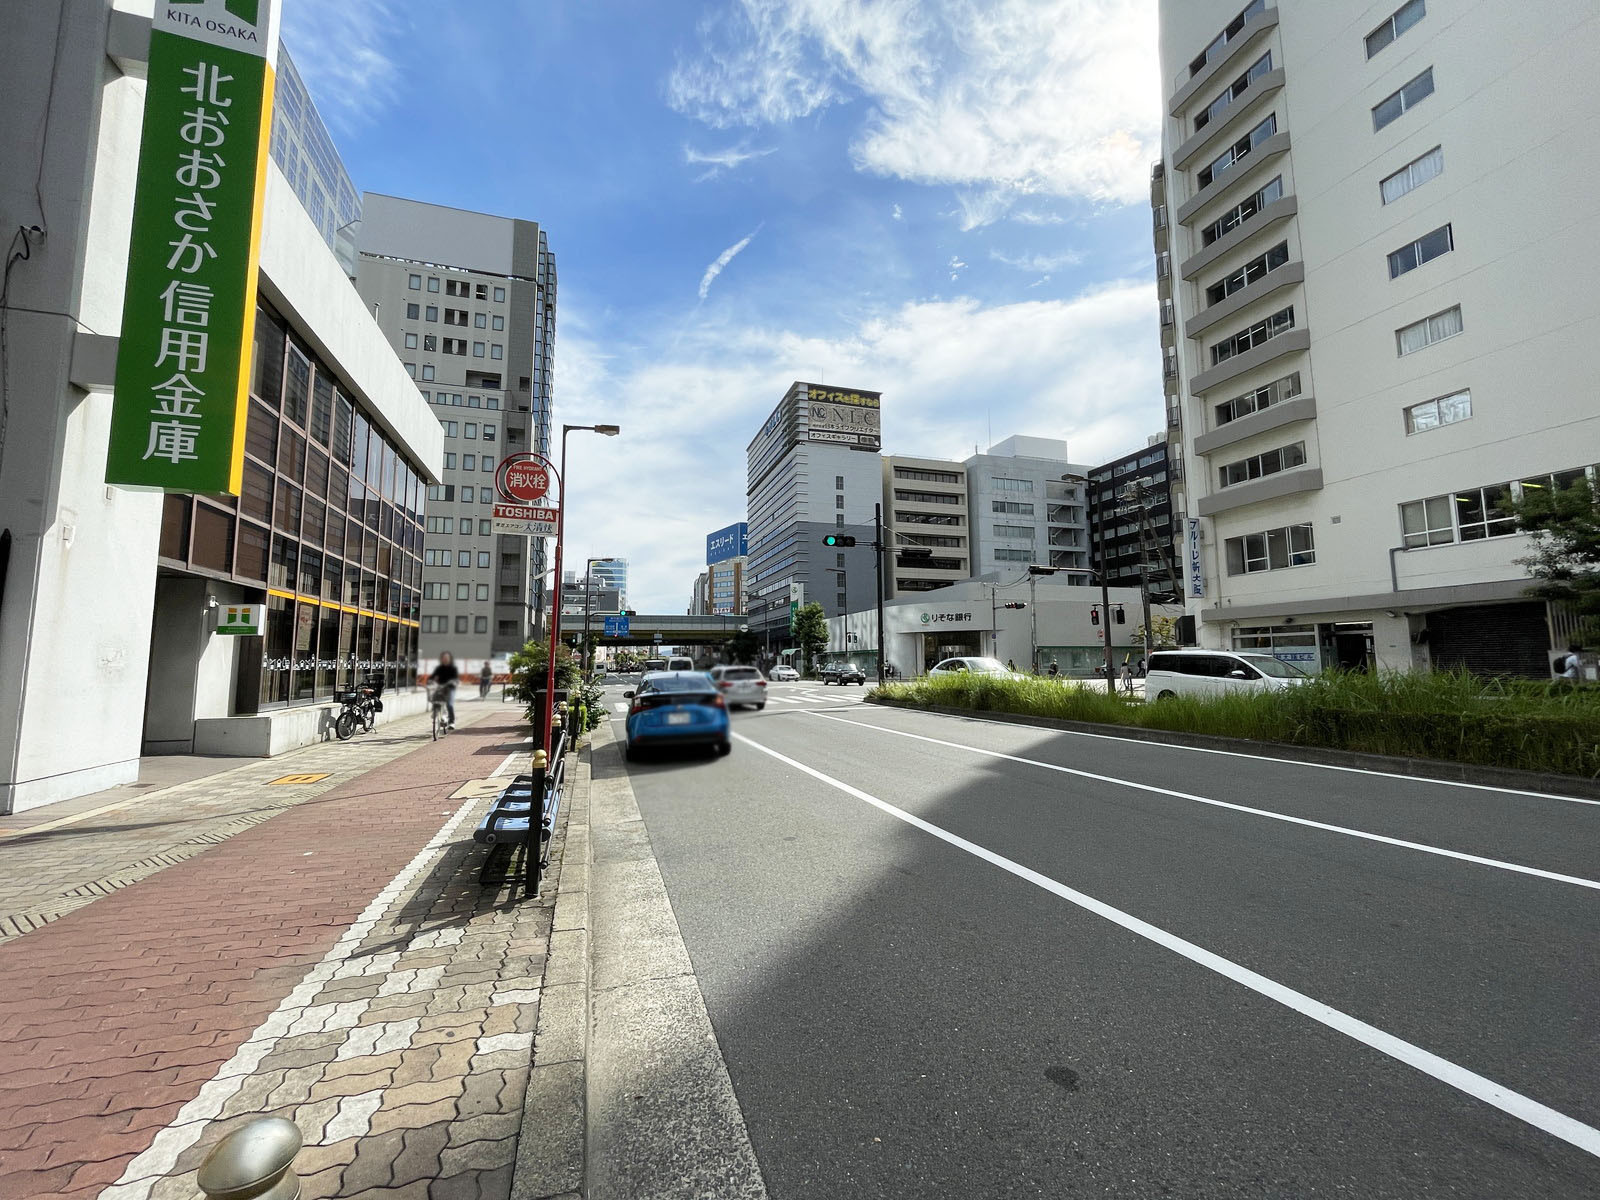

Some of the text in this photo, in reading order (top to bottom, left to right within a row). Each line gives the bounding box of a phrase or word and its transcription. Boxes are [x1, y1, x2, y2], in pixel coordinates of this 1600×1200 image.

[167, 9, 257, 42] KITA OSAKA
[142, 62, 234, 464] 北おおさか信用金庫
[510, 471, 546, 489] 消火栓
[497, 506, 554, 520] TOSHIBA
[711, 533, 735, 550] エスリード
[931, 613, 972, 623] りそな銀行
